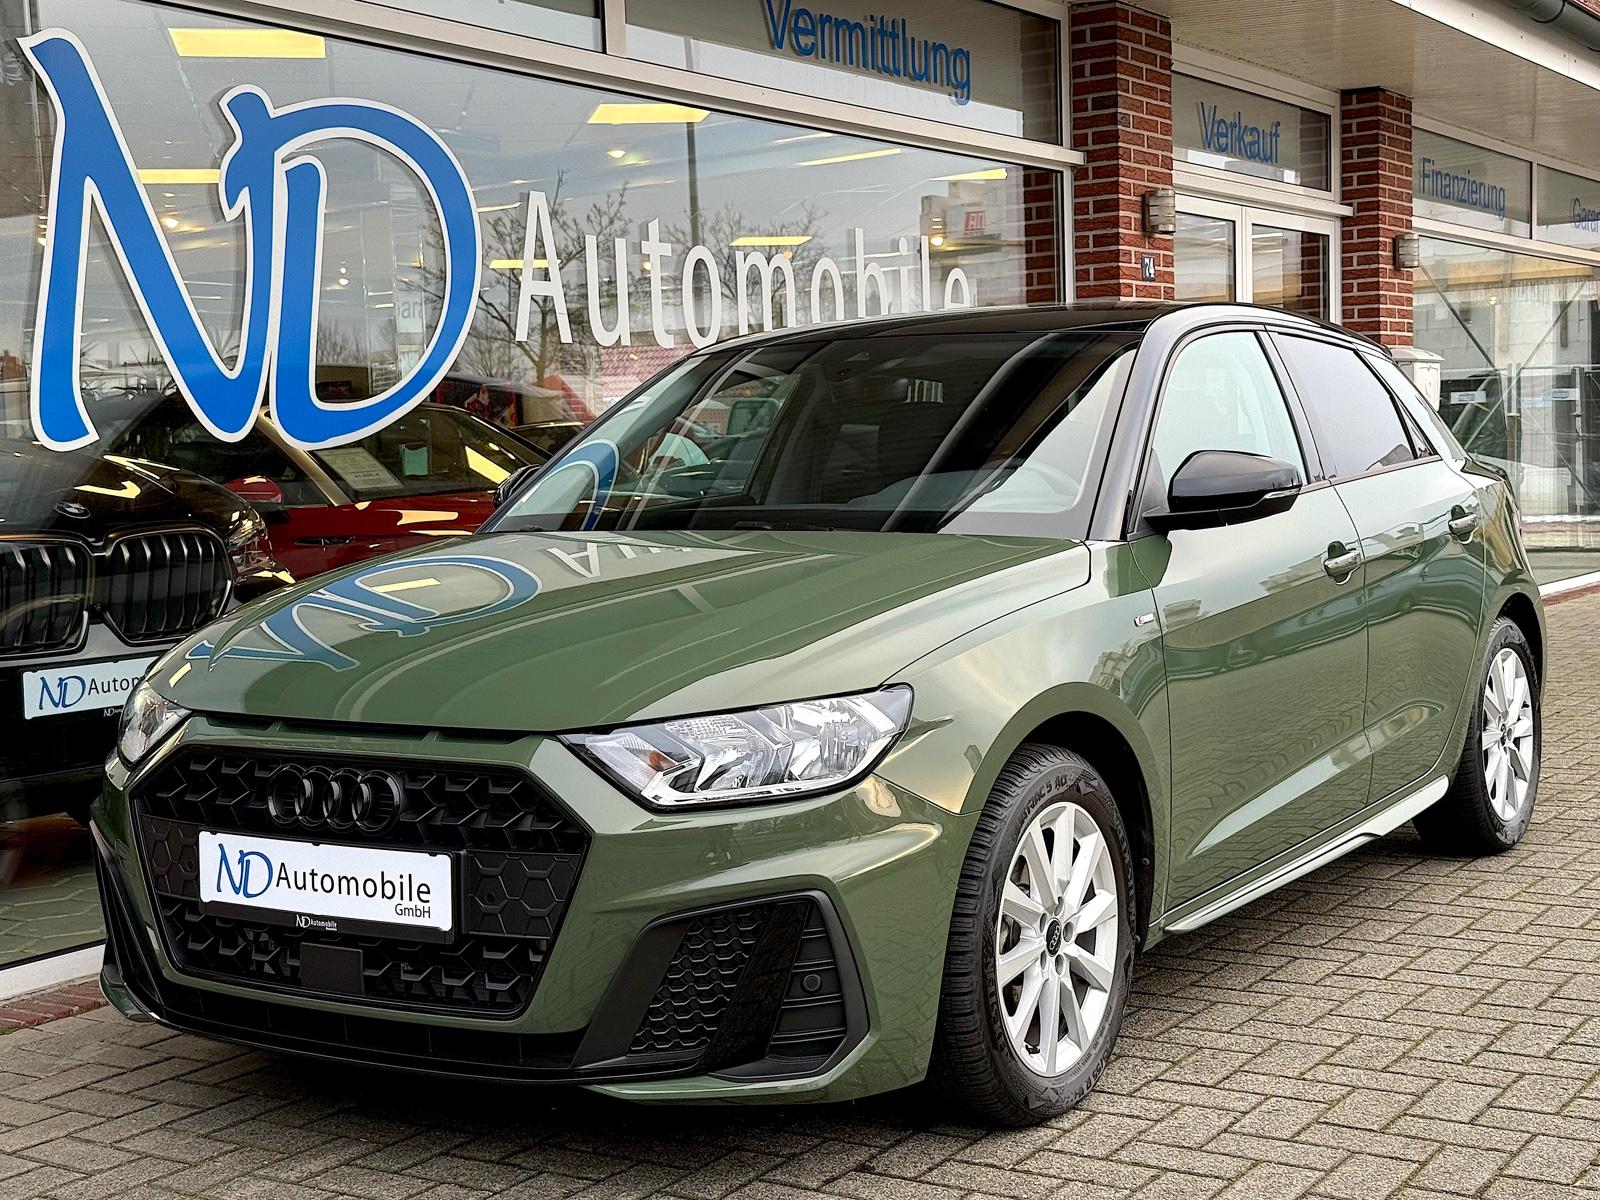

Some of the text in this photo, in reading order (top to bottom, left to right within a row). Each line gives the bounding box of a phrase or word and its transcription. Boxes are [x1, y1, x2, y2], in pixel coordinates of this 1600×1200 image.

[766, 0, 971, 106] Vermittlung
[1200, 102, 1280, 164] Verkauf
[1422, 157, 1505, 221] Finanzierung
[17, 28, 482, 450] ND
[38, 676, 86, 710] ND
[216, 843, 431, 903] ND Automobile
[295, 914, 310, 928] ND
[394, 903, 431, 919] GmbH
